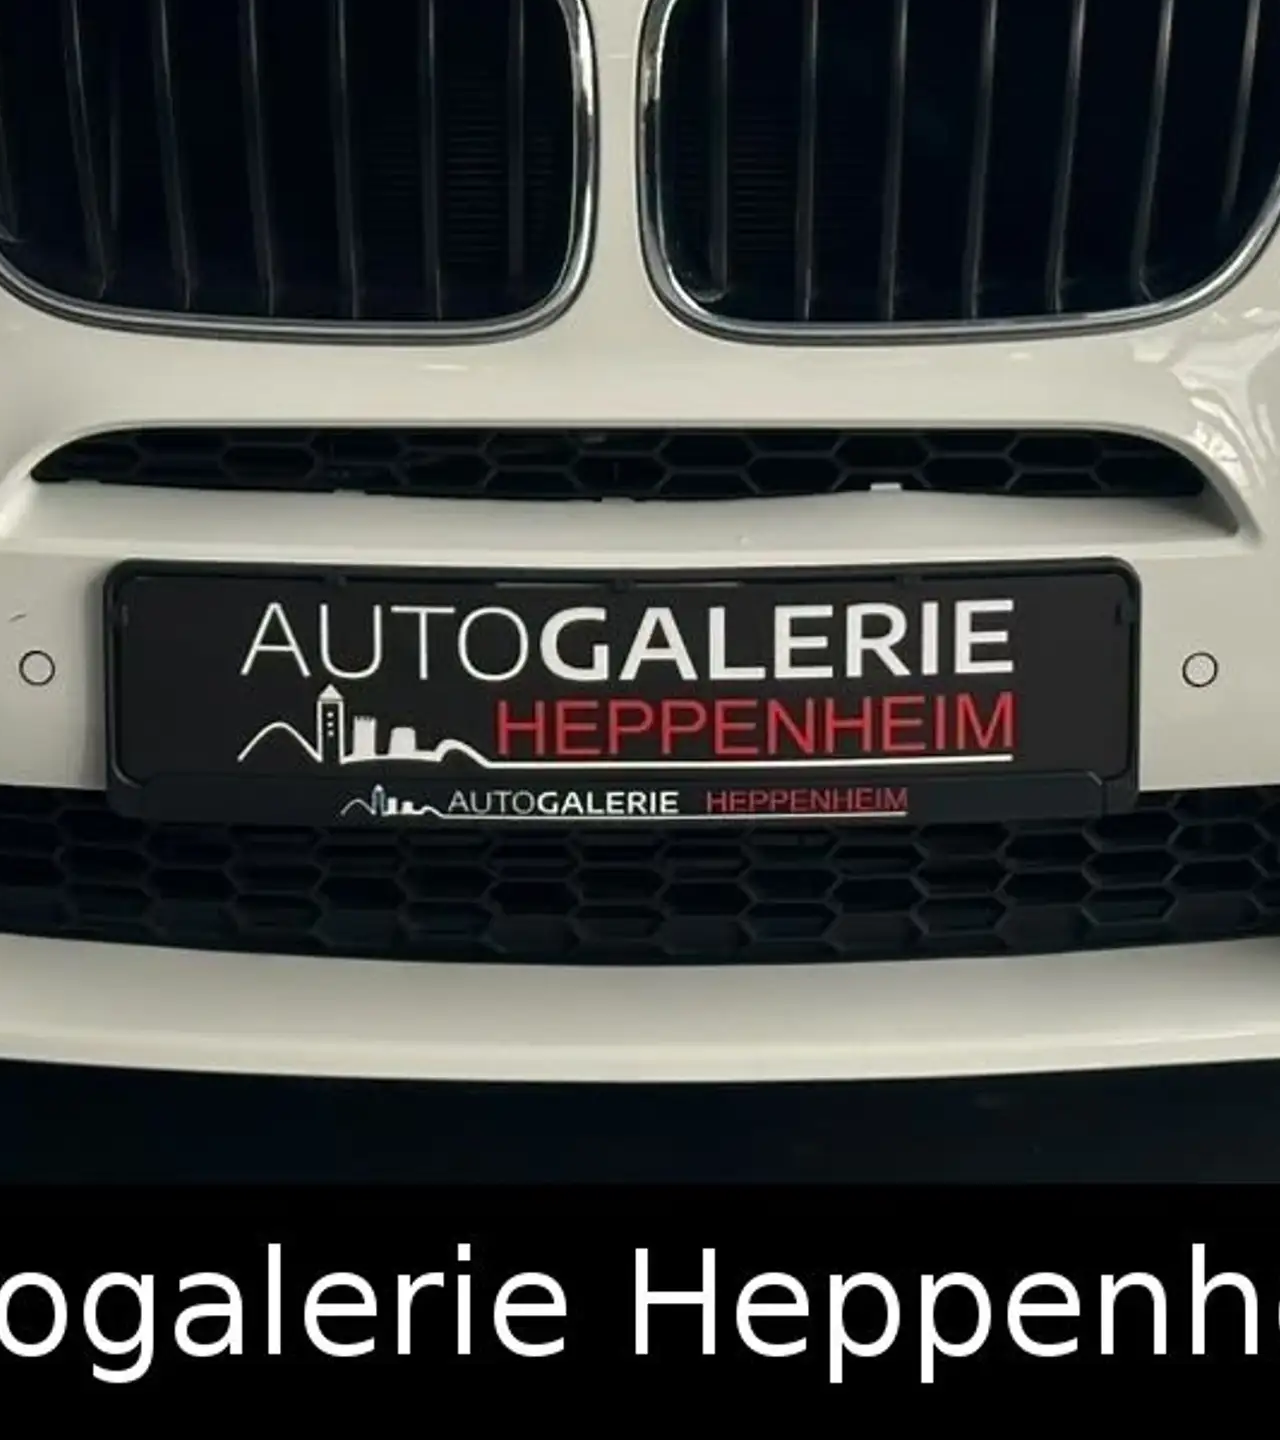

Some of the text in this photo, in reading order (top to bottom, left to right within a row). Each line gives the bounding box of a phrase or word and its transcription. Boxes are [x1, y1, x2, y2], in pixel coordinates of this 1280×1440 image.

[241, 600, 1014, 682] AUTOGALERIE
[498, 693, 1014, 756] HEPPENHEIM
[447, 788, 909, 816] AUTOGALERIE HEPPENHEIM
